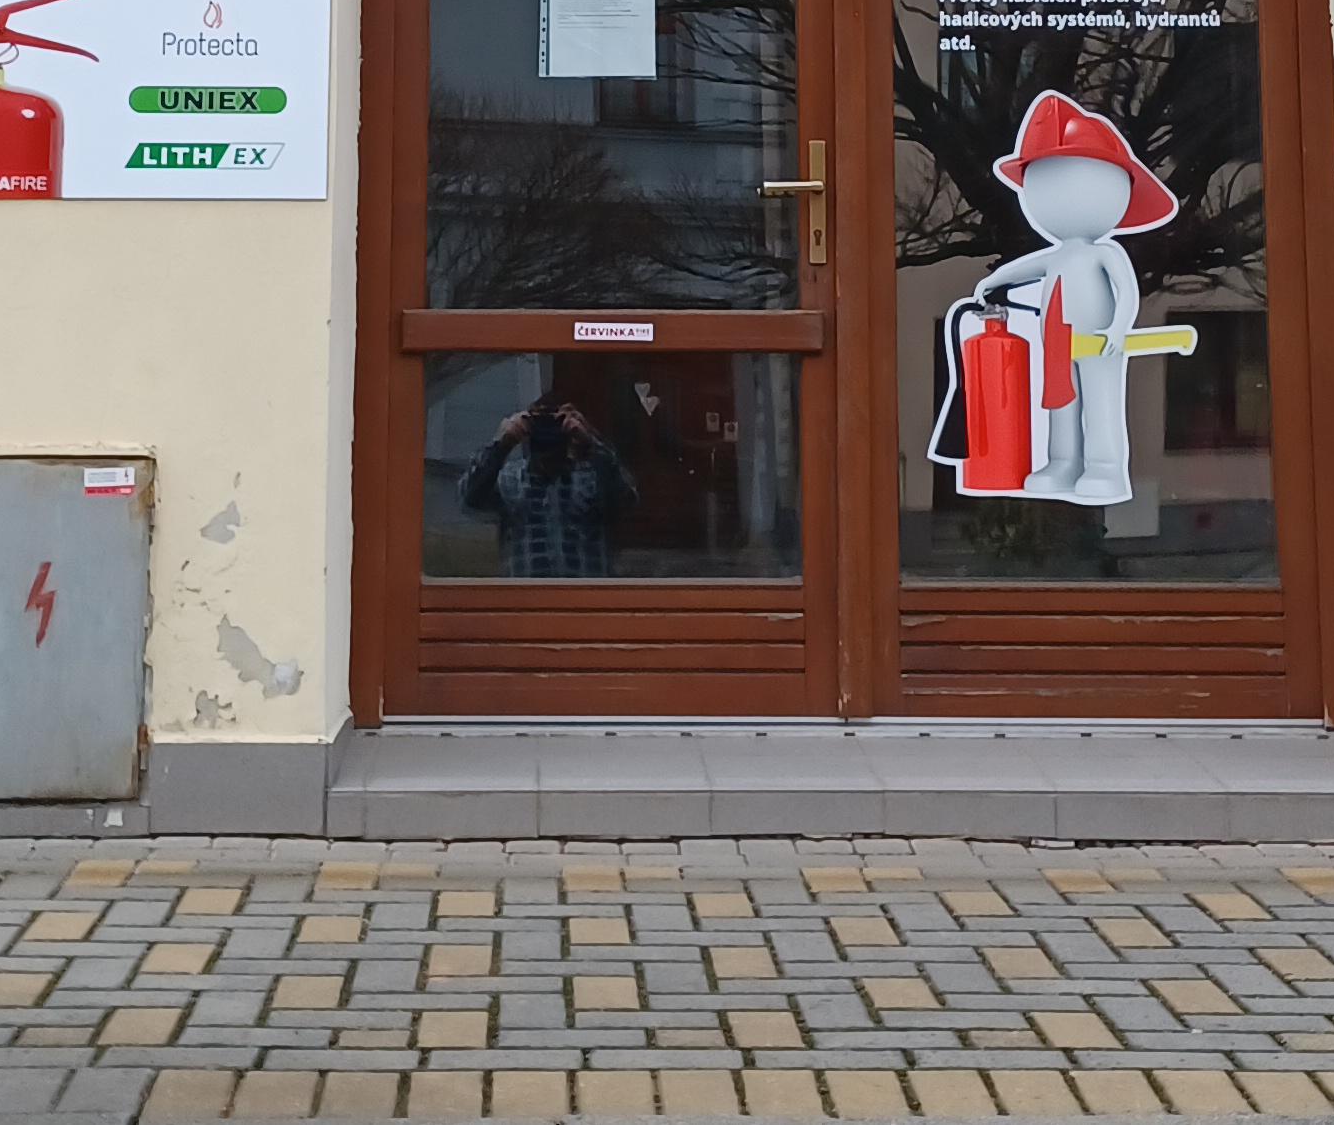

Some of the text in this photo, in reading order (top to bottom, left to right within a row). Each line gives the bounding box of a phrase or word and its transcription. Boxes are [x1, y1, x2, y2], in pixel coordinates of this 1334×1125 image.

[939, 10, 1221, 31] hadicových systémů, hydrantů
[162, 32, 259, 56] Protecta
[939, 35, 976, 51] atd.
[160, 91, 258, 110] UNIEX
